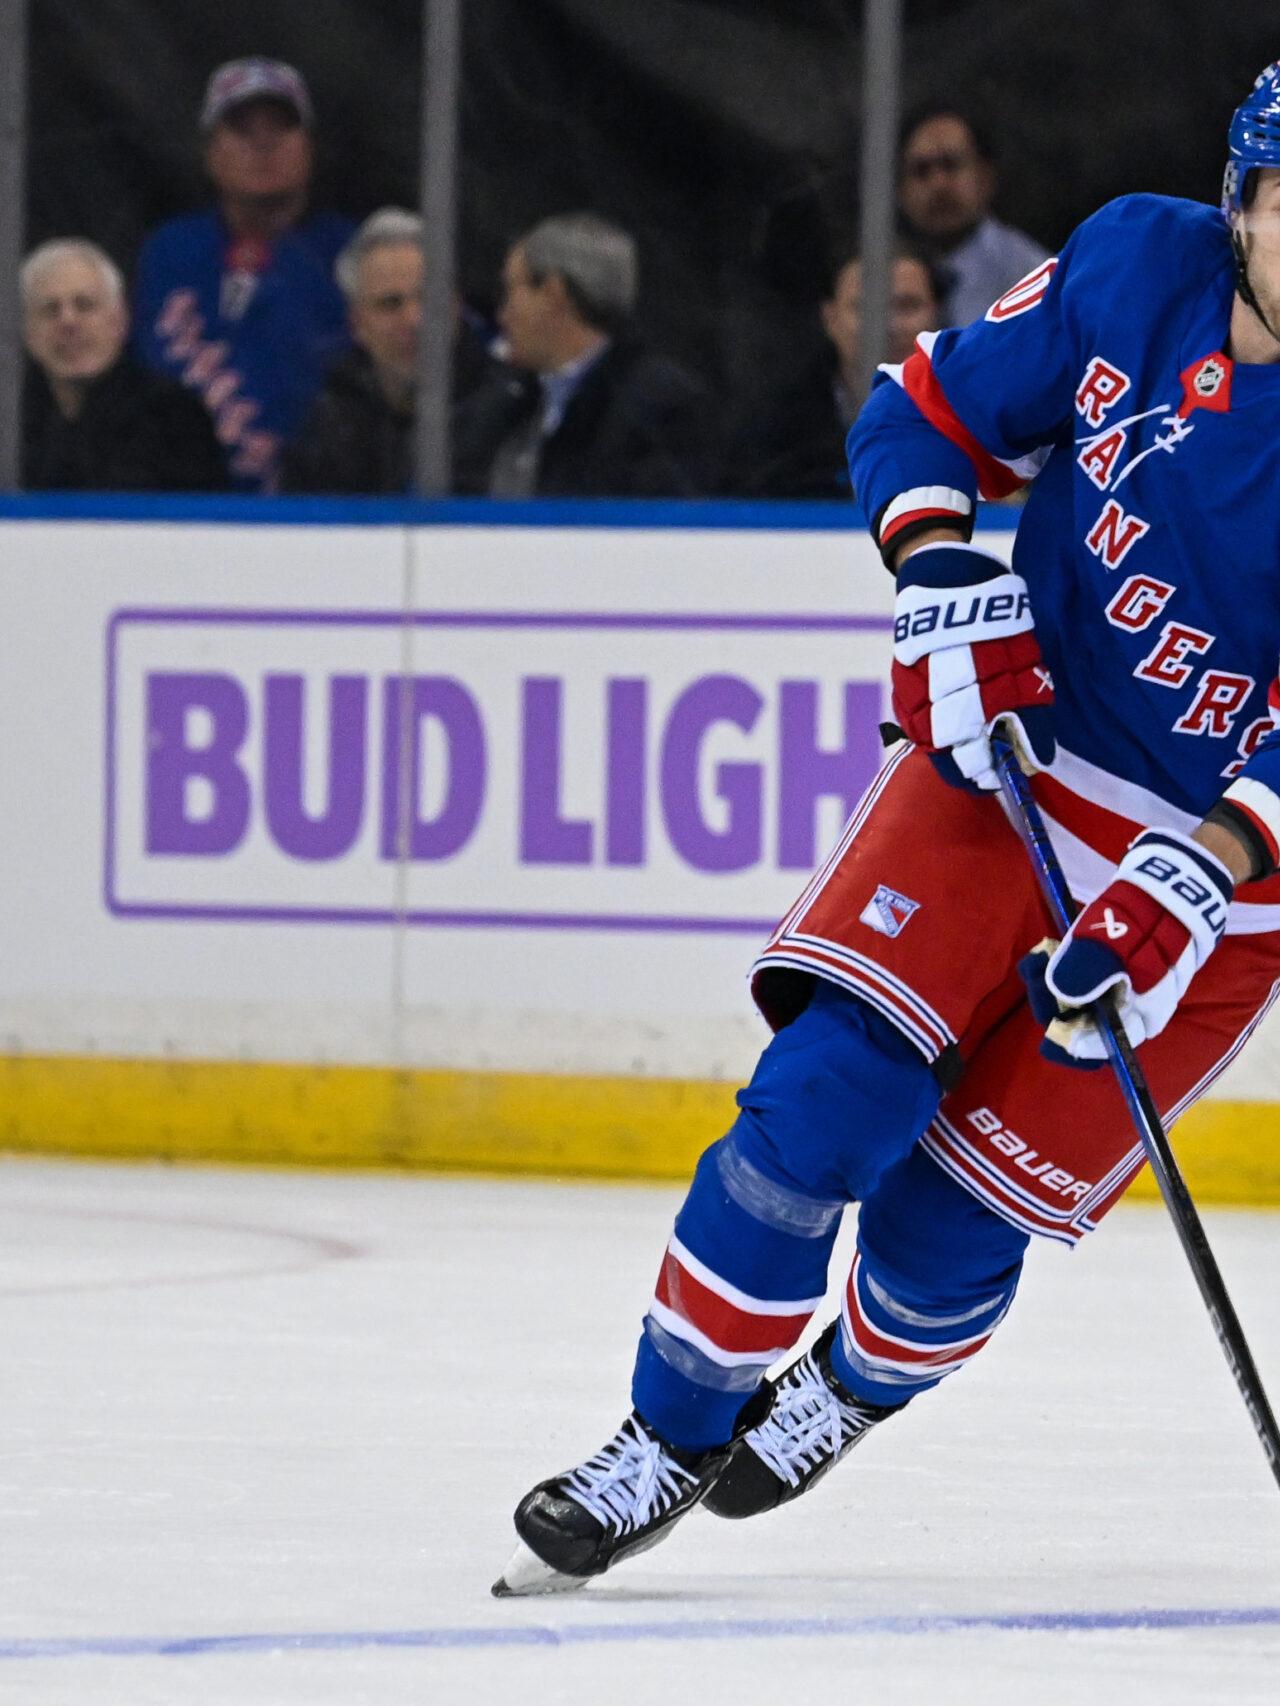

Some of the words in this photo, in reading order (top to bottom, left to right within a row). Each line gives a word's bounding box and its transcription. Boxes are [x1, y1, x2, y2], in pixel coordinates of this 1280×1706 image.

[144, 670, 489, 863] BUD
[518, 673, 884, 875] LIGH
[1134, 855, 1226, 949] BAU
[966, 1107, 1093, 1201] BAUER
